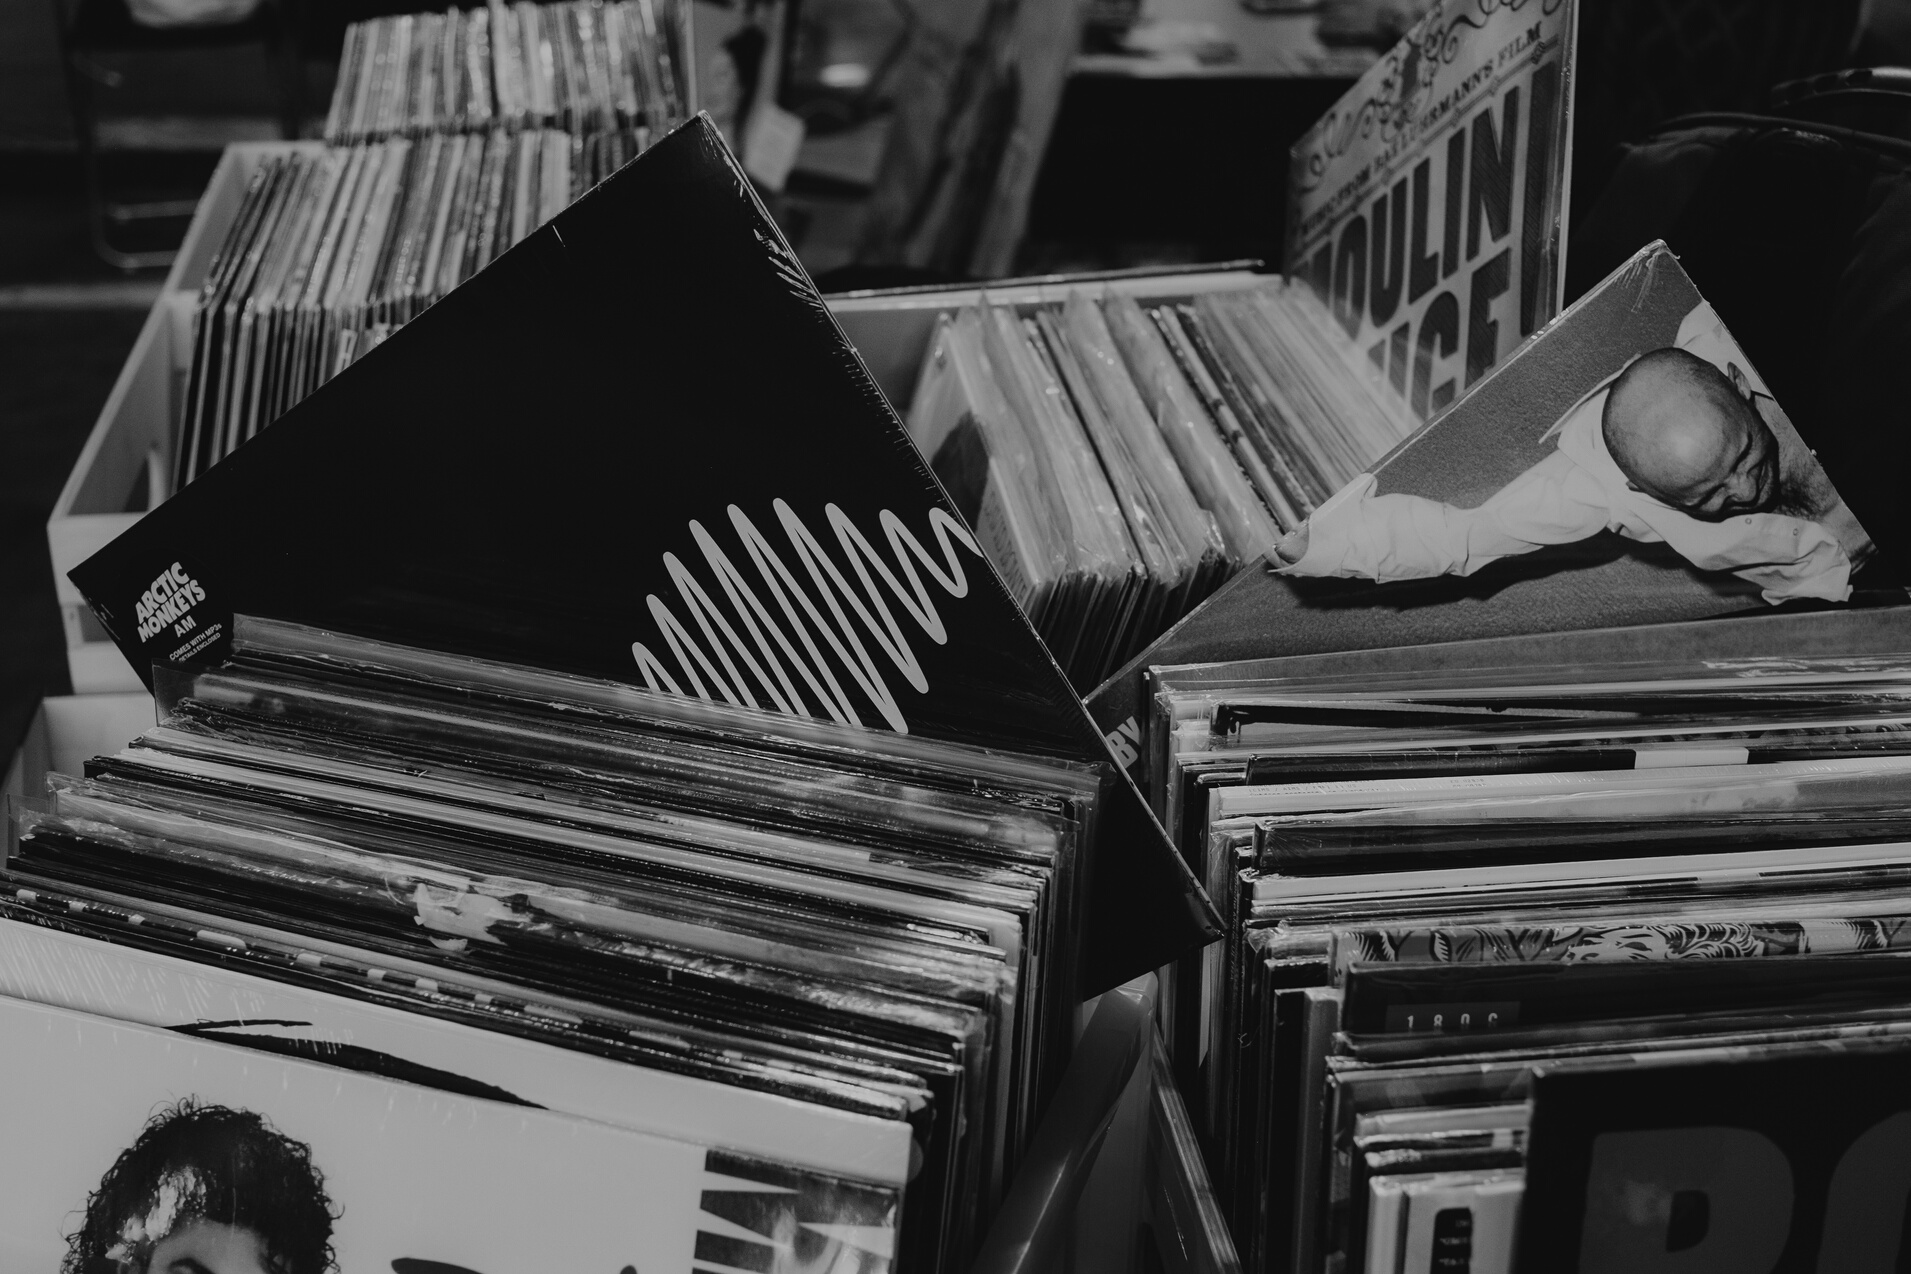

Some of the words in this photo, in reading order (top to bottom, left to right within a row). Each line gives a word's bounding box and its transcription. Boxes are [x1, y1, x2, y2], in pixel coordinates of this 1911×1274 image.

[1499, 21, 1542, 65] FILM
[135, 561, 190, 625] ARCTIC
[137, 579, 206, 643] MONKEYS
[174, 614, 197, 638] AM
[196, 632, 221, 651] ENCLOSED
[169, 643, 192, 661] COMES
[189, 632, 207, 647] WITH
